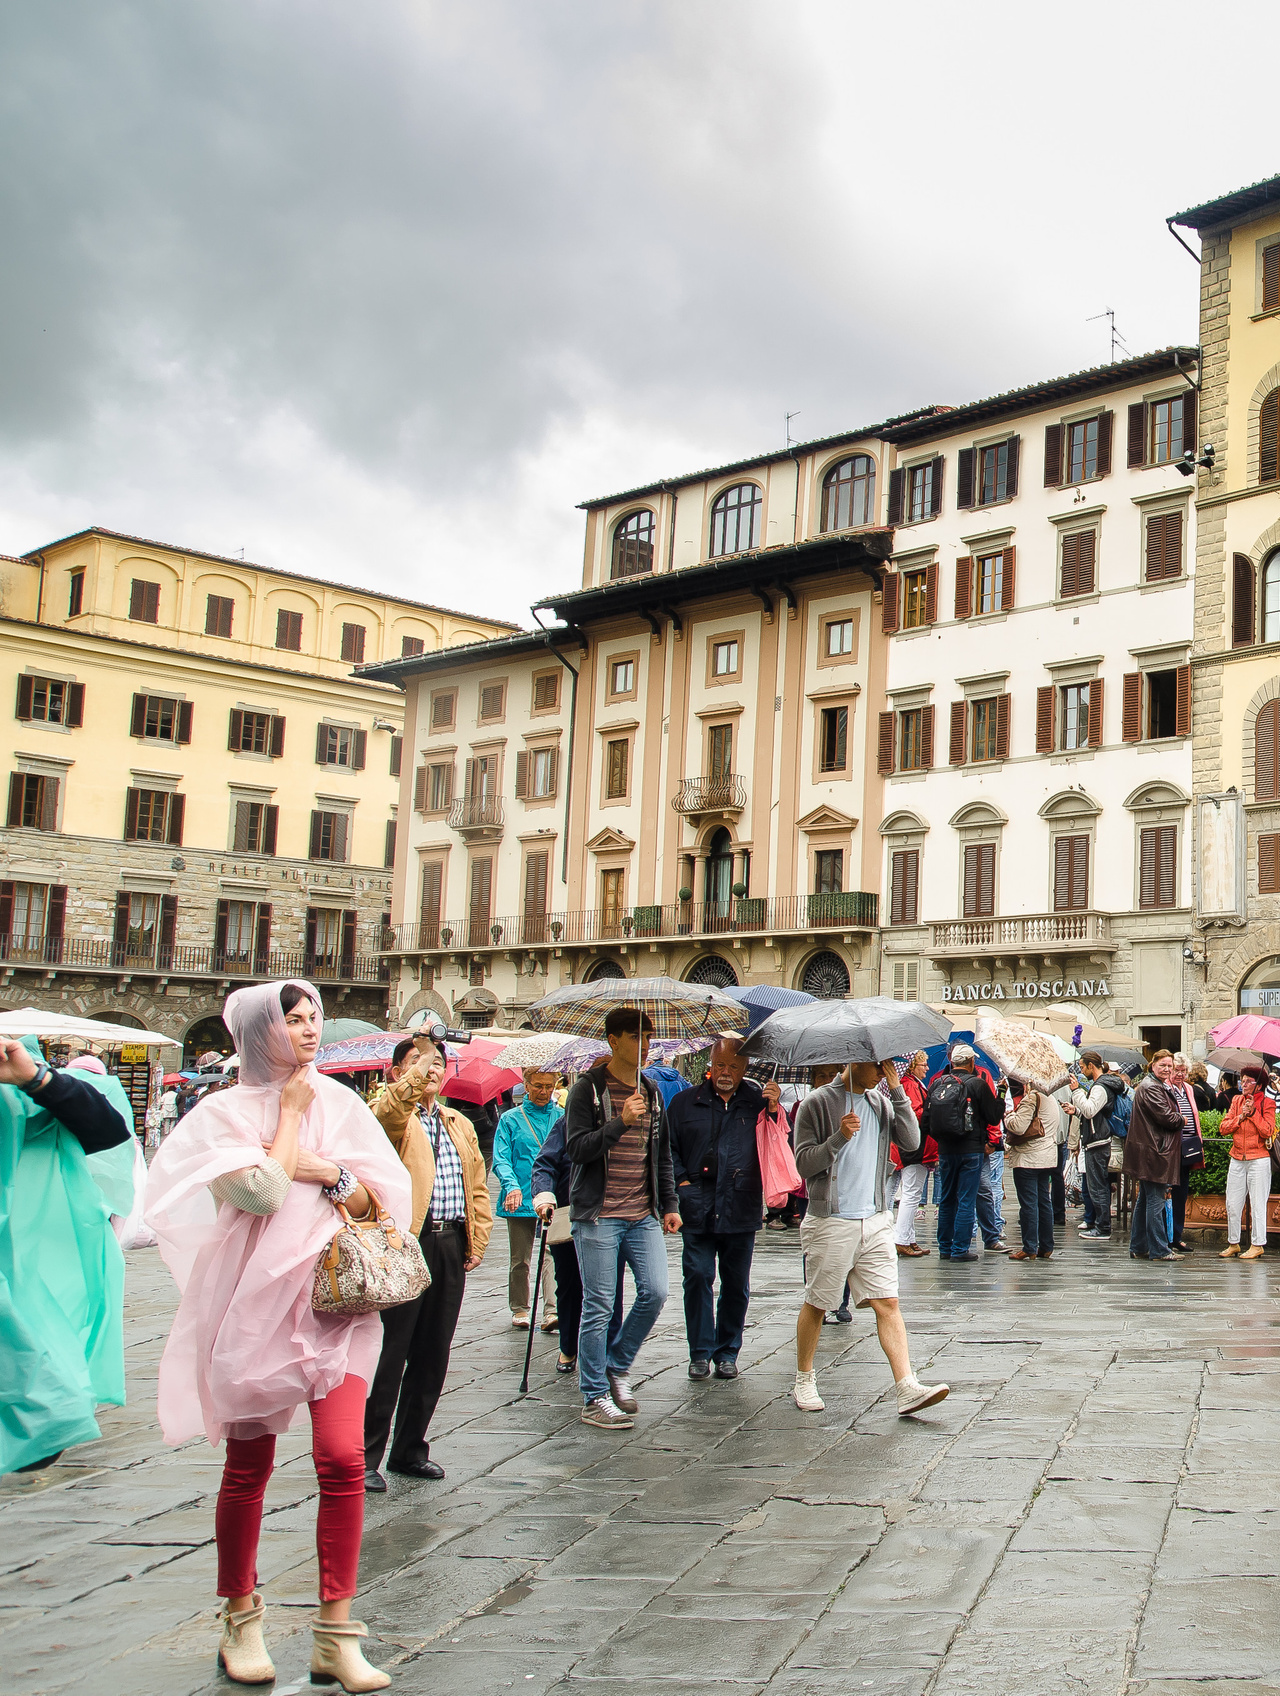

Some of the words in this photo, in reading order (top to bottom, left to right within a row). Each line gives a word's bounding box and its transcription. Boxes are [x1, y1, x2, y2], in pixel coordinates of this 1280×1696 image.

[208, 861, 262, 877] REALE
[281, 868, 330, 884] MUTUA
[940, 983, 1005, 1001] BANCA
[1012, 979, 1110, 999] TOSCANA
